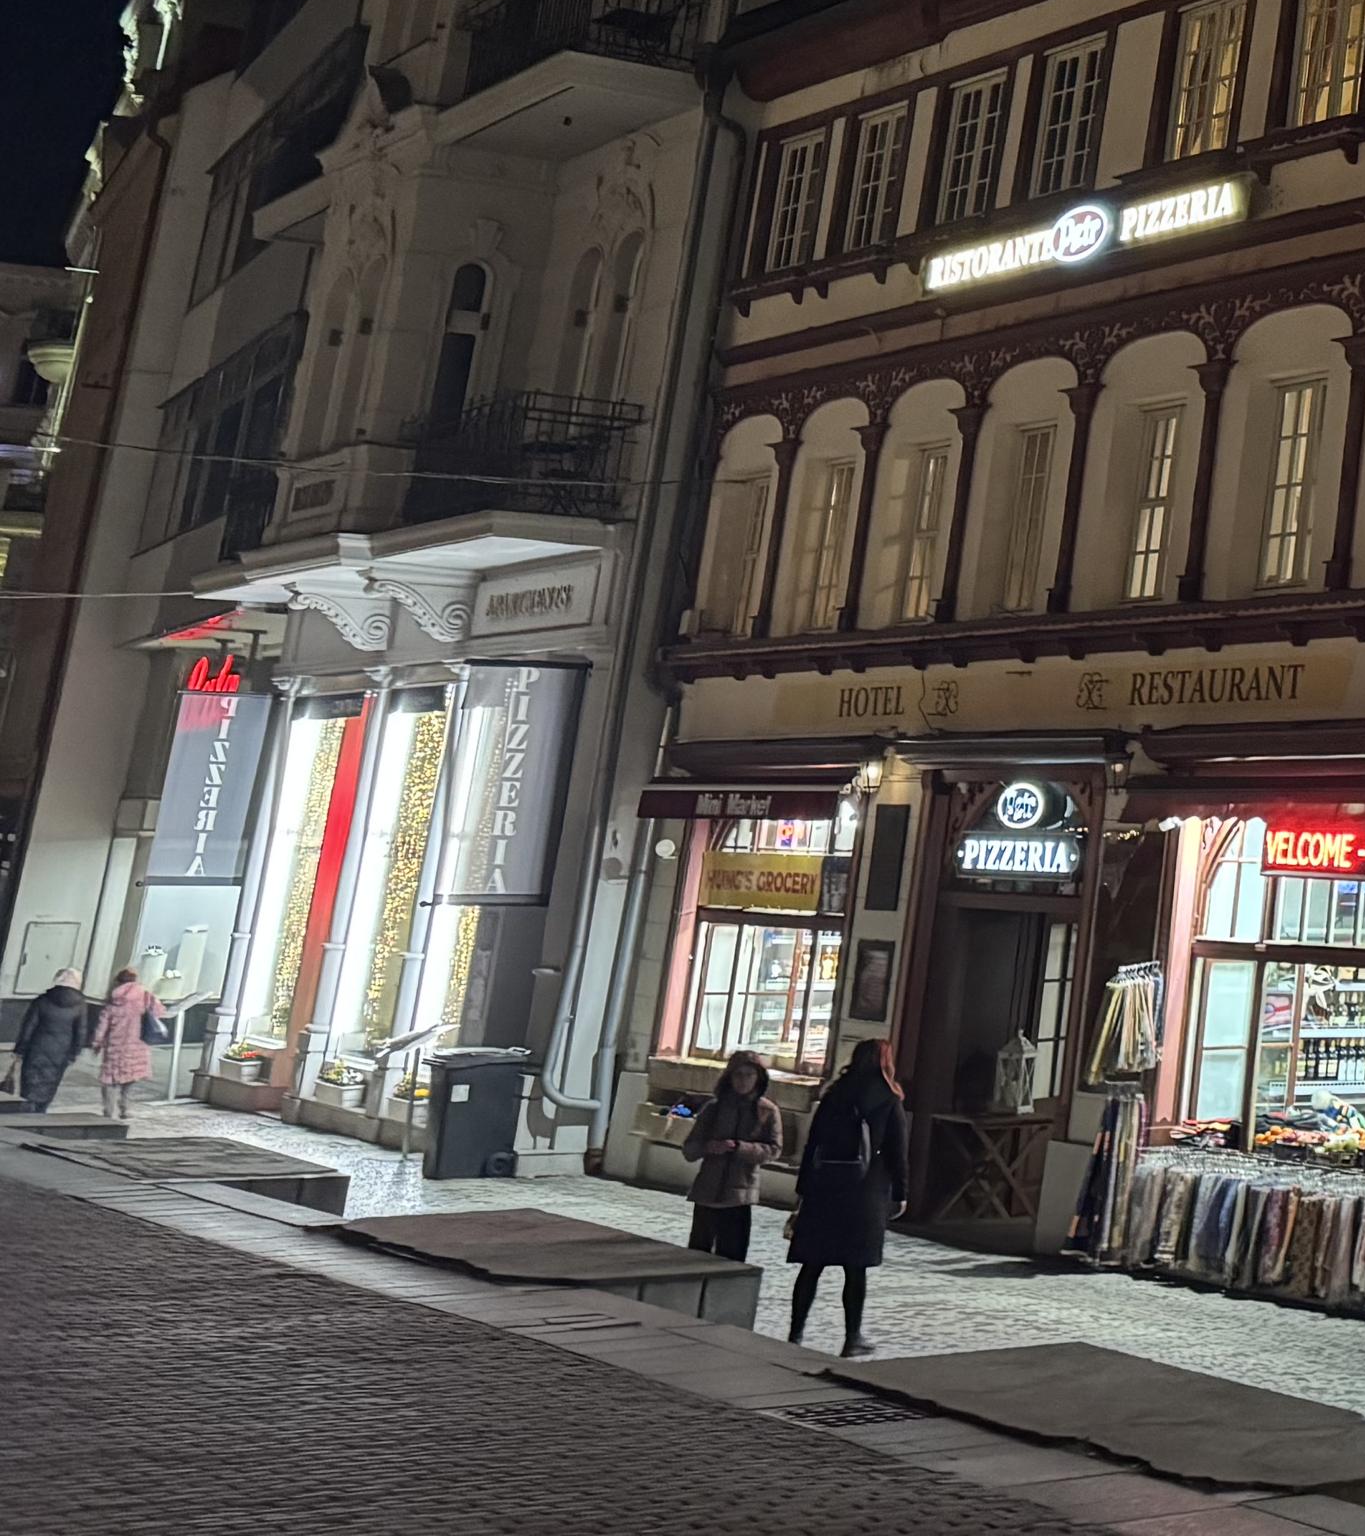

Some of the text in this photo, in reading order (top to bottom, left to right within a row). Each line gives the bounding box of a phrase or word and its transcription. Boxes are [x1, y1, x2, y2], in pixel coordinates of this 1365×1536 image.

[1119, 182, 1235, 242] PIZZERIA
[838, 664, 1306, 718] HOTEL RESTAURANT
[487, 667, 541, 893] PIZZERIA
[756, 871, 818, 895] GROCERY
[962, 839, 1070, 873] PIZZERIA
